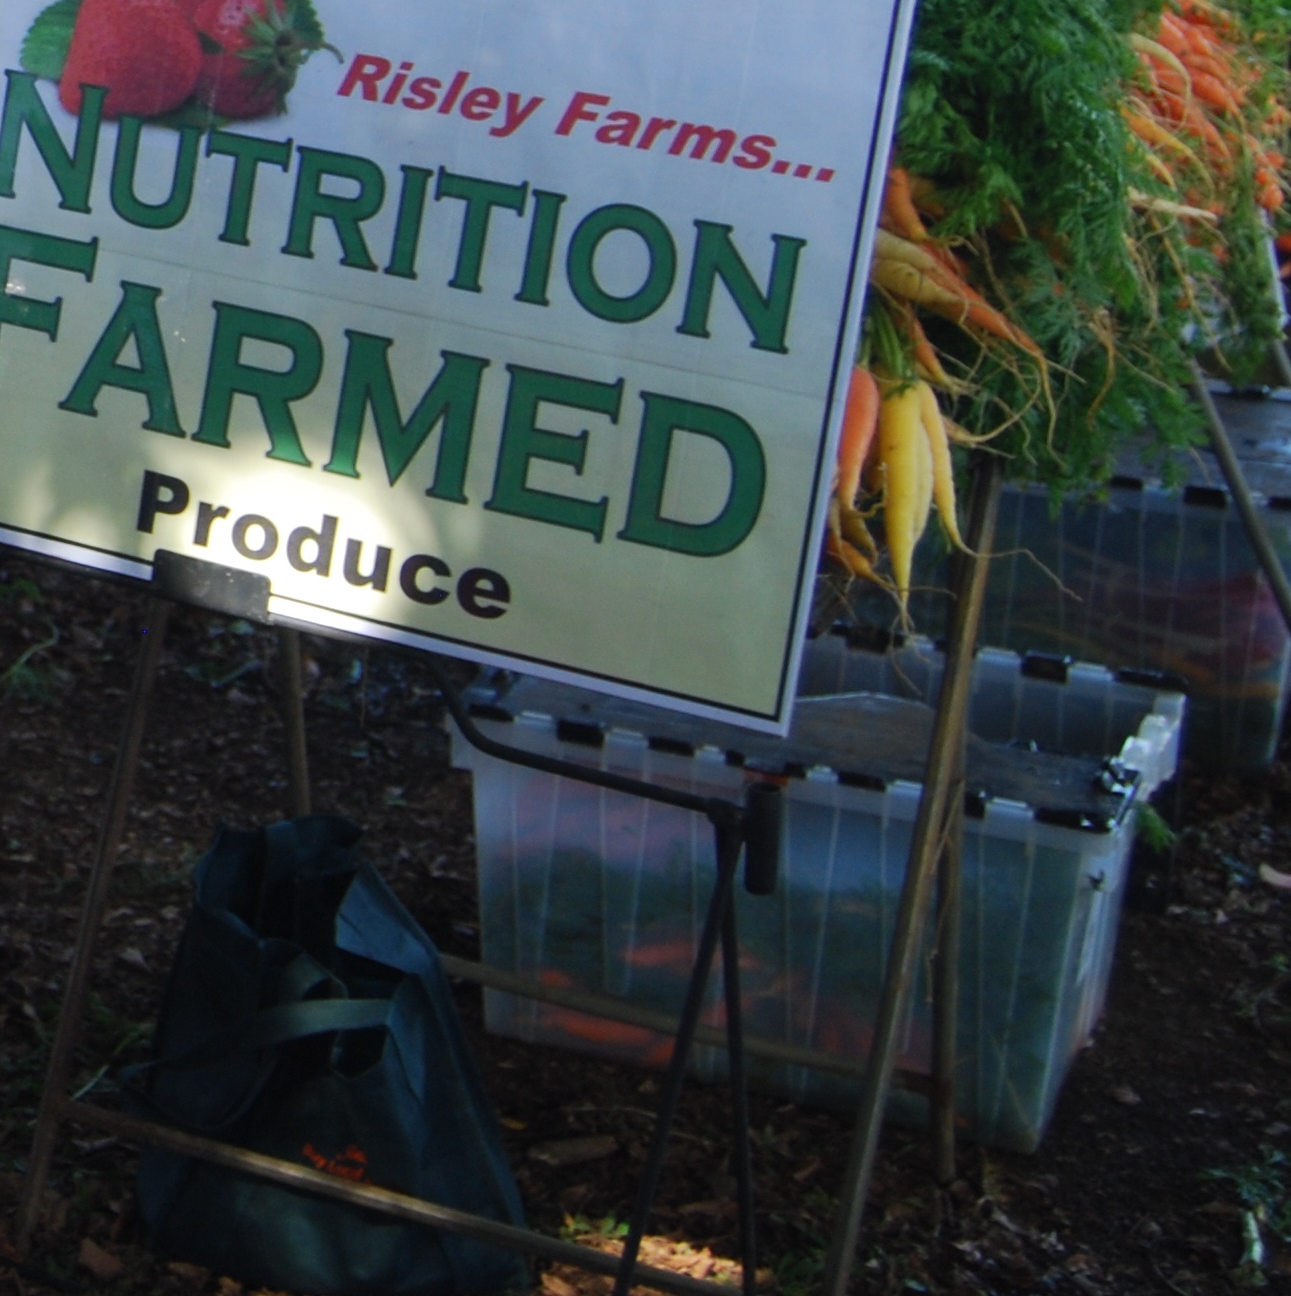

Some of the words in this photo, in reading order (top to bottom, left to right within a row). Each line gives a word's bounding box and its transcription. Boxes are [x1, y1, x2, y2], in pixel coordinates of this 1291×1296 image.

[334, 53, 545, 139] Risley
[553, 90, 837, 183] Farms...
[136, 469, 515, 621] Produce
